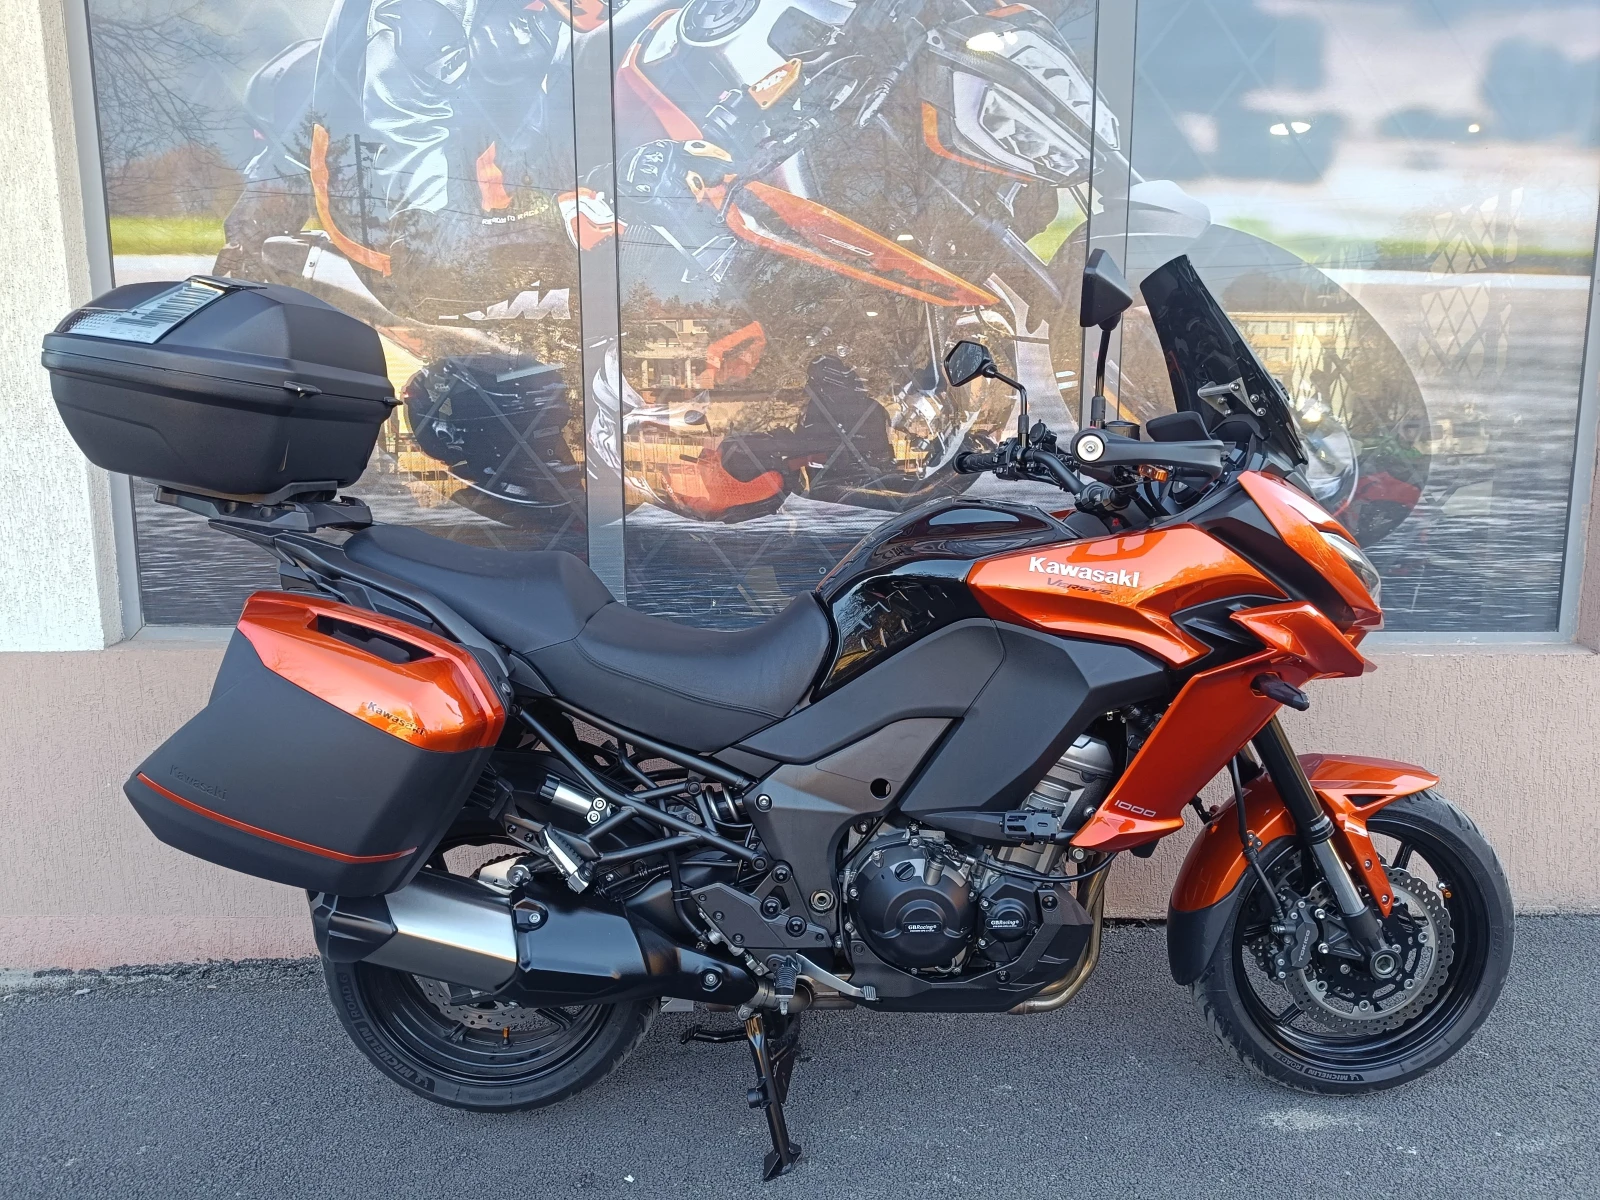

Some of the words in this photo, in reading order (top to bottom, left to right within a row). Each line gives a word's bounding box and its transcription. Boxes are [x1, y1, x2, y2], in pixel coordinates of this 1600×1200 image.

[1029, 556, 1140, 588] Kawasaki
[1047, 577, 1113, 596] VERSYS
[169, 764, 228, 801] Kawasaki
[1114, 799, 1157, 818] 1000
[1298, 929, 1311, 962] TOKICO
[341, 986, 361, 1019] ROAD
[360, 1026, 415, 1079] MICHELIN
[1280, 1056, 1302, 1070] ROAD
[1307, 1068, 1350, 1082] MICHELIN
